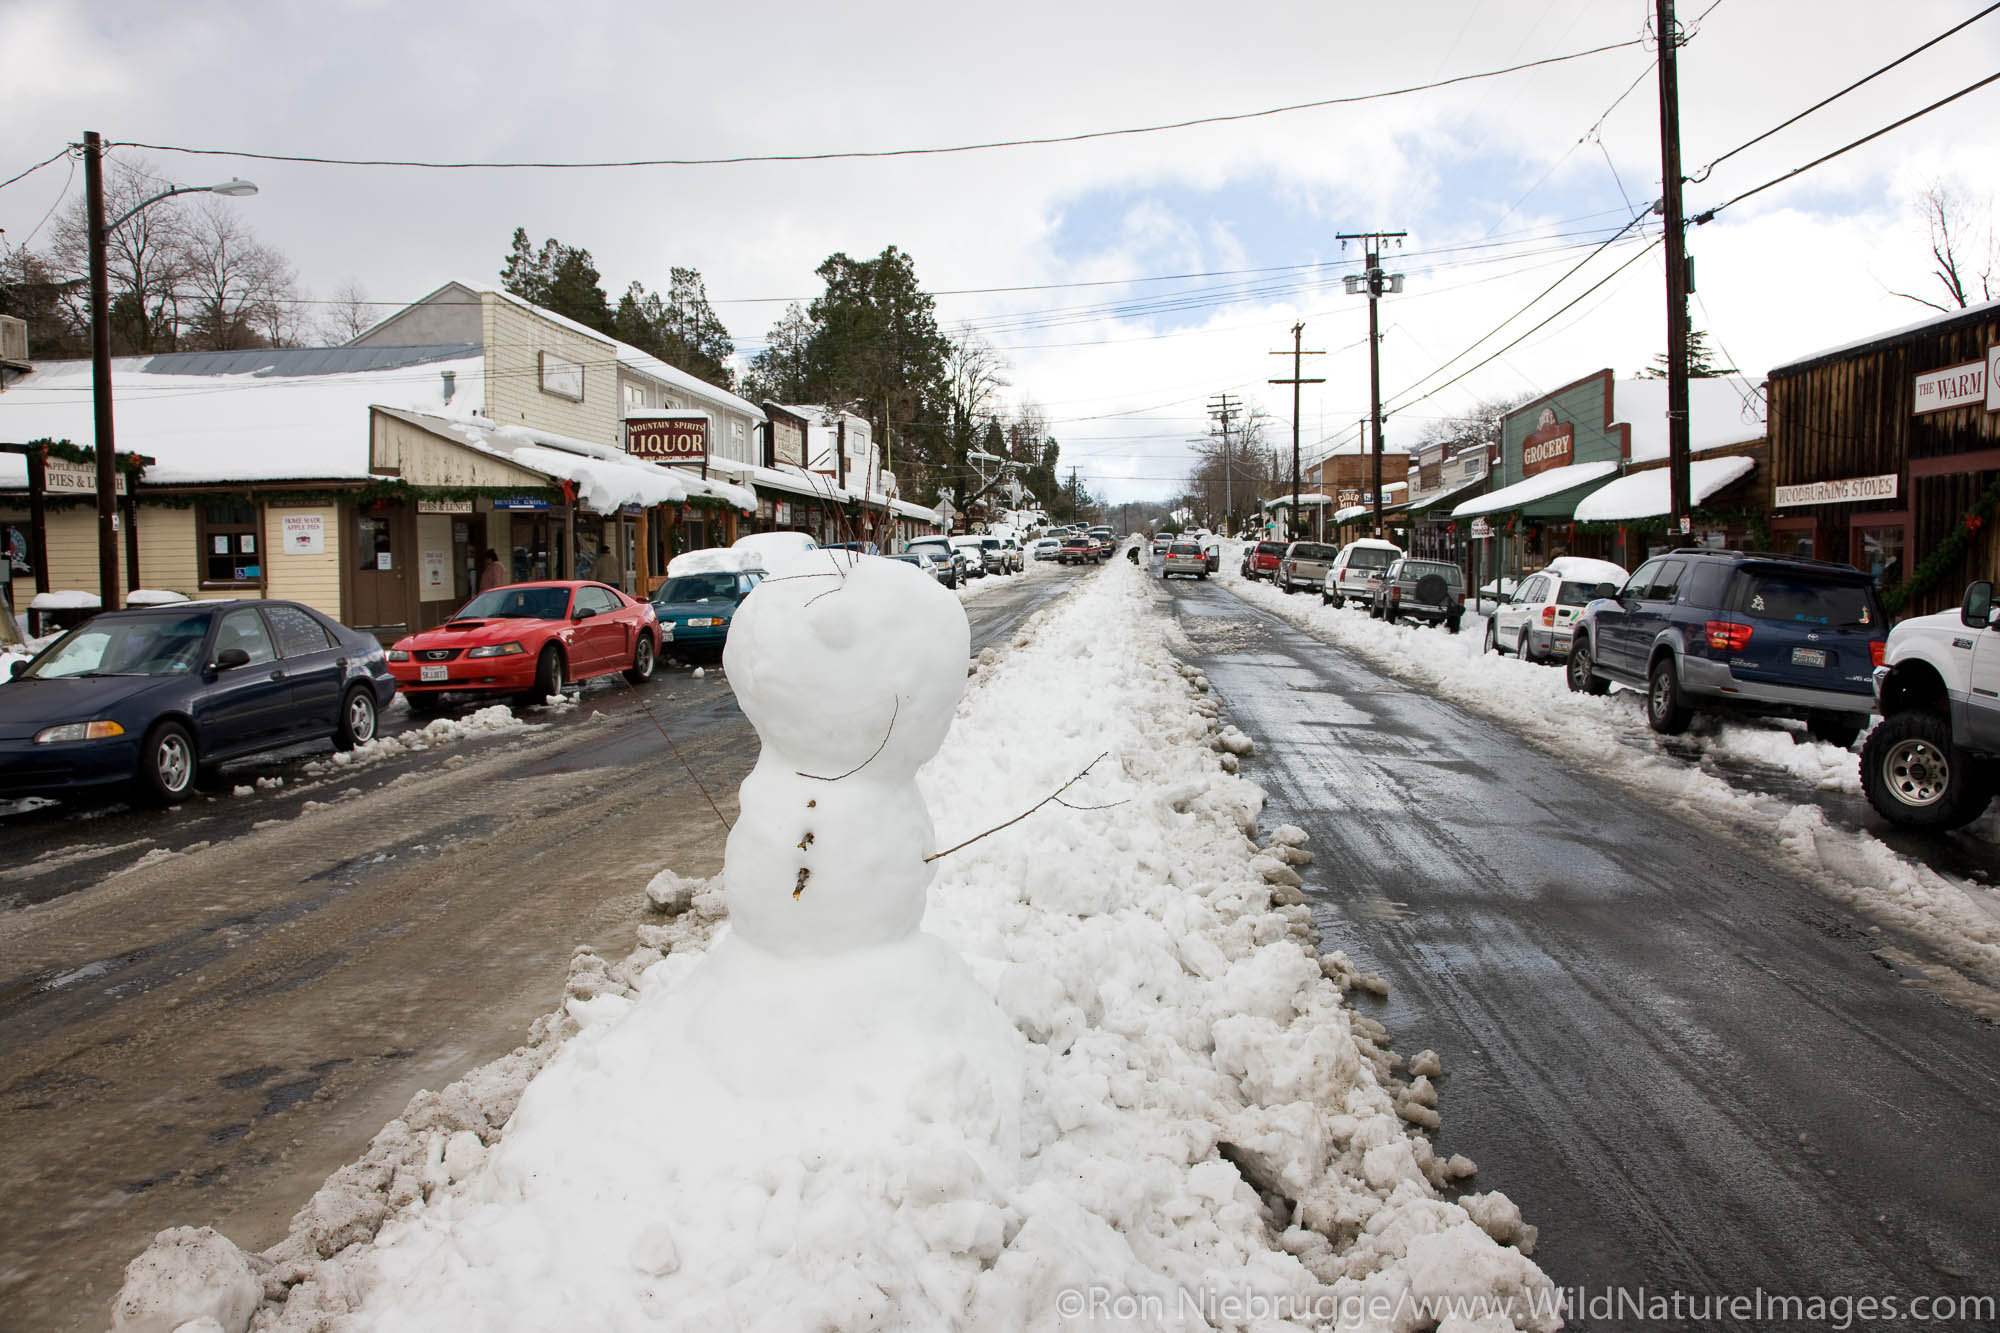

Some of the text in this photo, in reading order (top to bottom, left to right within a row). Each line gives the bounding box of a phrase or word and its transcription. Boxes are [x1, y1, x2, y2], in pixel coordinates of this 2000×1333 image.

[1918, 370, 1984, 400] THE WARM
[630, 421, 705, 433] MOUNTAIN SPIRITS
[630, 434, 704, 455] LIQUOR
[1524, 434, 1570, 465] GROCERY
[48, 473, 74, 488] PIES
[76, 475, 85, 488] &
[1338, 493, 1360, 502] CIDER
[1779, 478, 1893, 504] WOODBURNING STOVES
[419, 502, 437, 512] PIES
[445, 503, 472, 512] LUNCH
